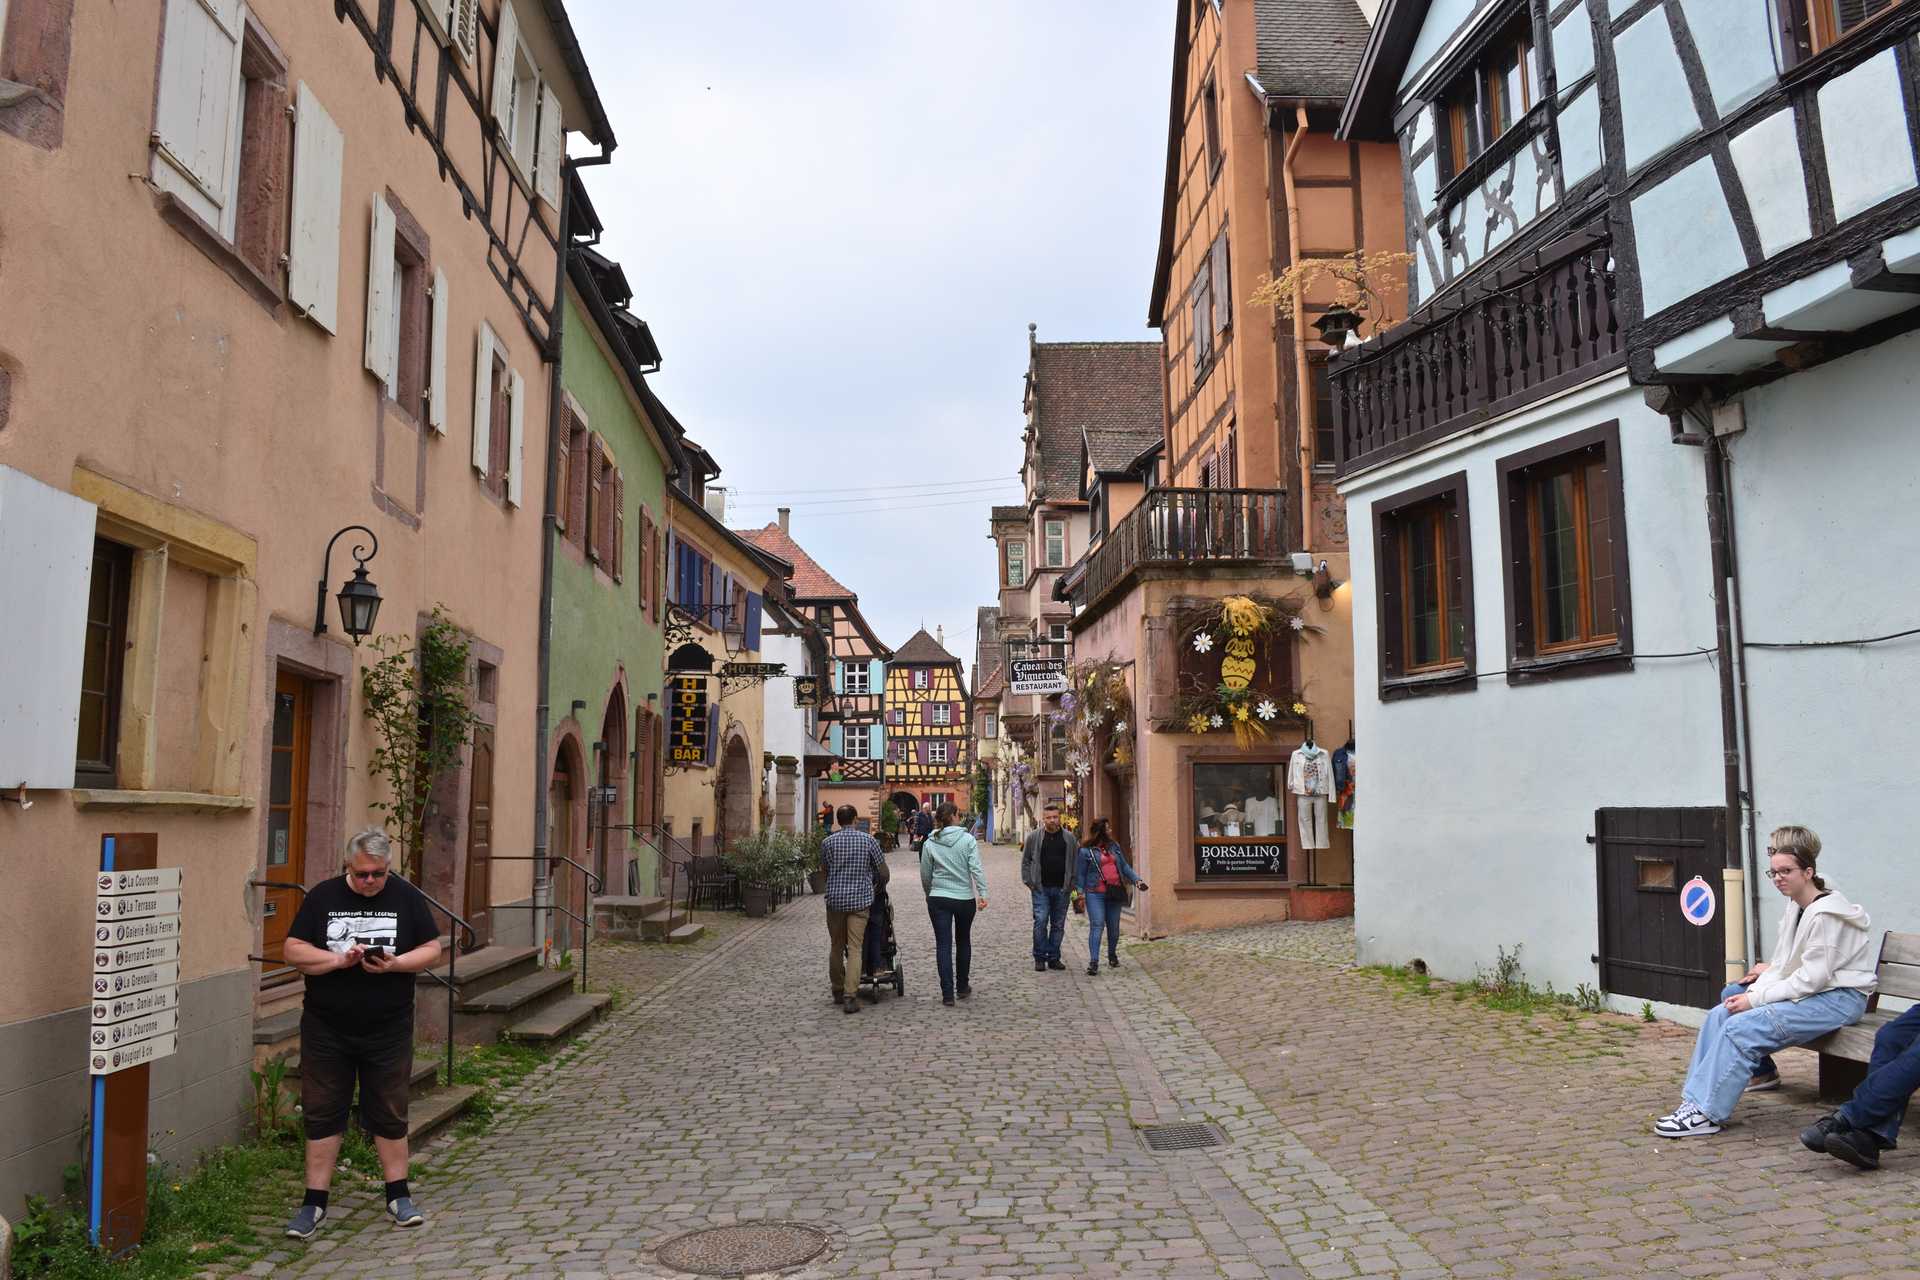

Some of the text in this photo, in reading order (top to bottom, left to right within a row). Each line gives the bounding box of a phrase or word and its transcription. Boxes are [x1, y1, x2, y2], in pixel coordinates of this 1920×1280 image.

[728, 664, 775, 674] HOTEL
[1048, 661, 1063, 670] des
[1016, 682, 1062, 691] RESTAURANT
[681, 678, 697, 745] HOTEL
[674, 748, 701, 760] BAR
[1201, 846, 1280, 858] BORSALINO
[127, 875, 159, 888] La Couronne
[126, 900, 157, 912] La Terrasse
[124, 977, 130, 989] La
[133, 1021, 158, 1035] Couronne
